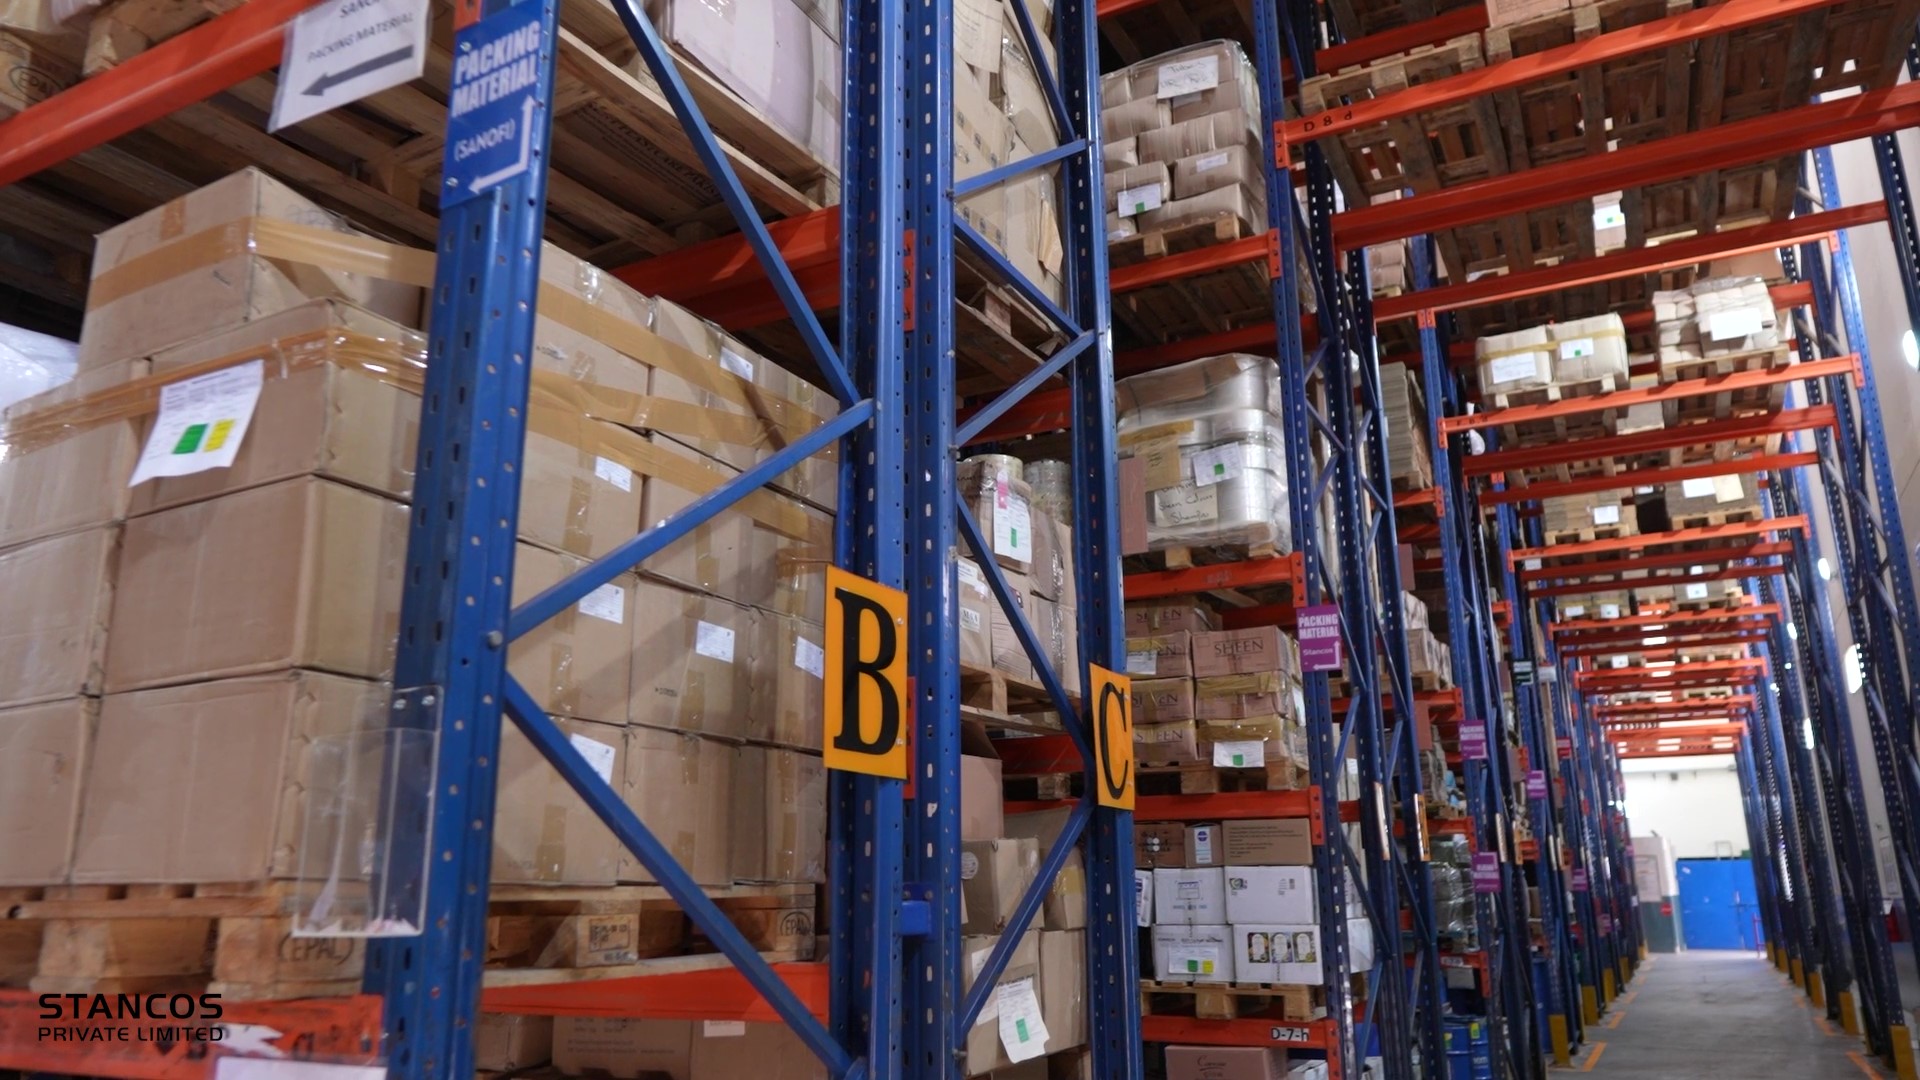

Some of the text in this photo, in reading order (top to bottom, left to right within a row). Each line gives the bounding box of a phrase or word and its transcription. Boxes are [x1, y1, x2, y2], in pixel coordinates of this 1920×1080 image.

[308, 12, 414, 62] PACKING MATERIAL
[454, 20, 541, 85] PACKING
[452, 53, 538, 118] MATERIAL
[454, 118, 516, 162] (SANOFI)
[1303, 121, 1315, 132] D
[1323, 115, 1333, 126] 8
[1299, 614, 1338, 628] PACKING
[1299, 626, 1340, 639] MATERIAL
[1214, 640, 1264, 655] SHEEN
[833, 587, 900, 756] B
[1098, 681, 1129, 801] C
[1271, 1027, 1310, 1041] D-7-h
